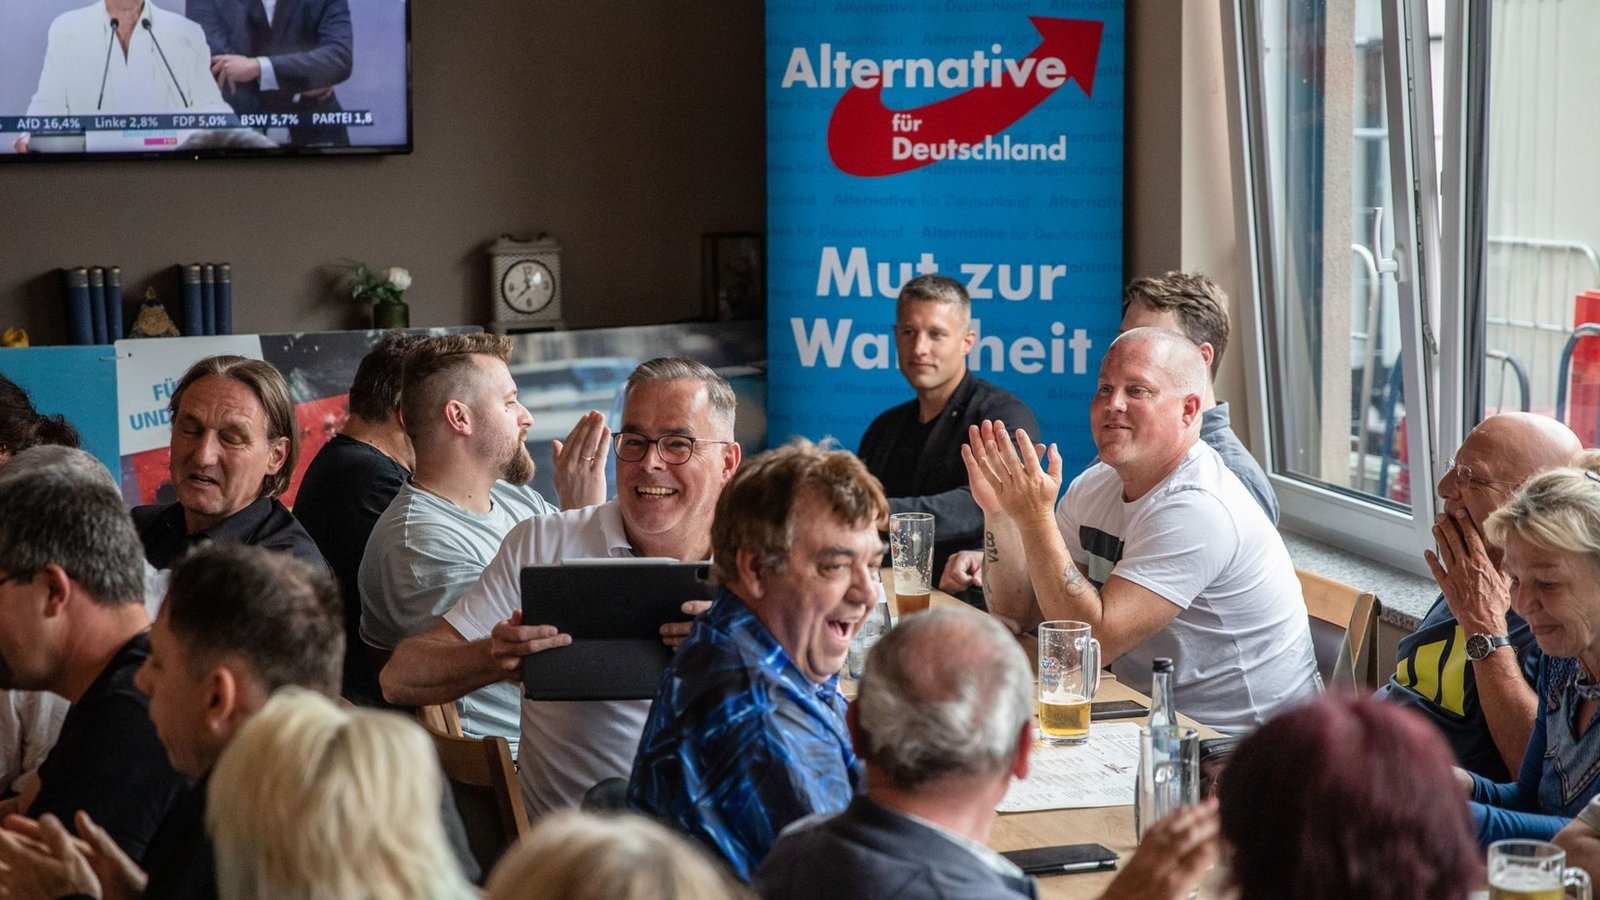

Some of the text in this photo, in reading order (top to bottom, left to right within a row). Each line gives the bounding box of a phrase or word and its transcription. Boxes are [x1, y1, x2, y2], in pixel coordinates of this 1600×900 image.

[781, 43, 1067, 89] Alternative
[17, 112, 373, 130] AfD 16,4% Linke 2,8% FDP 5,0% BSW 5,7% PARTEI 1,8
[892, 113, 922, 132] für
[892, 135, 1067, 161] Deutschland
[961, 263, 1067, 301] zur
[790, 317, 1092, 375] Waheit
